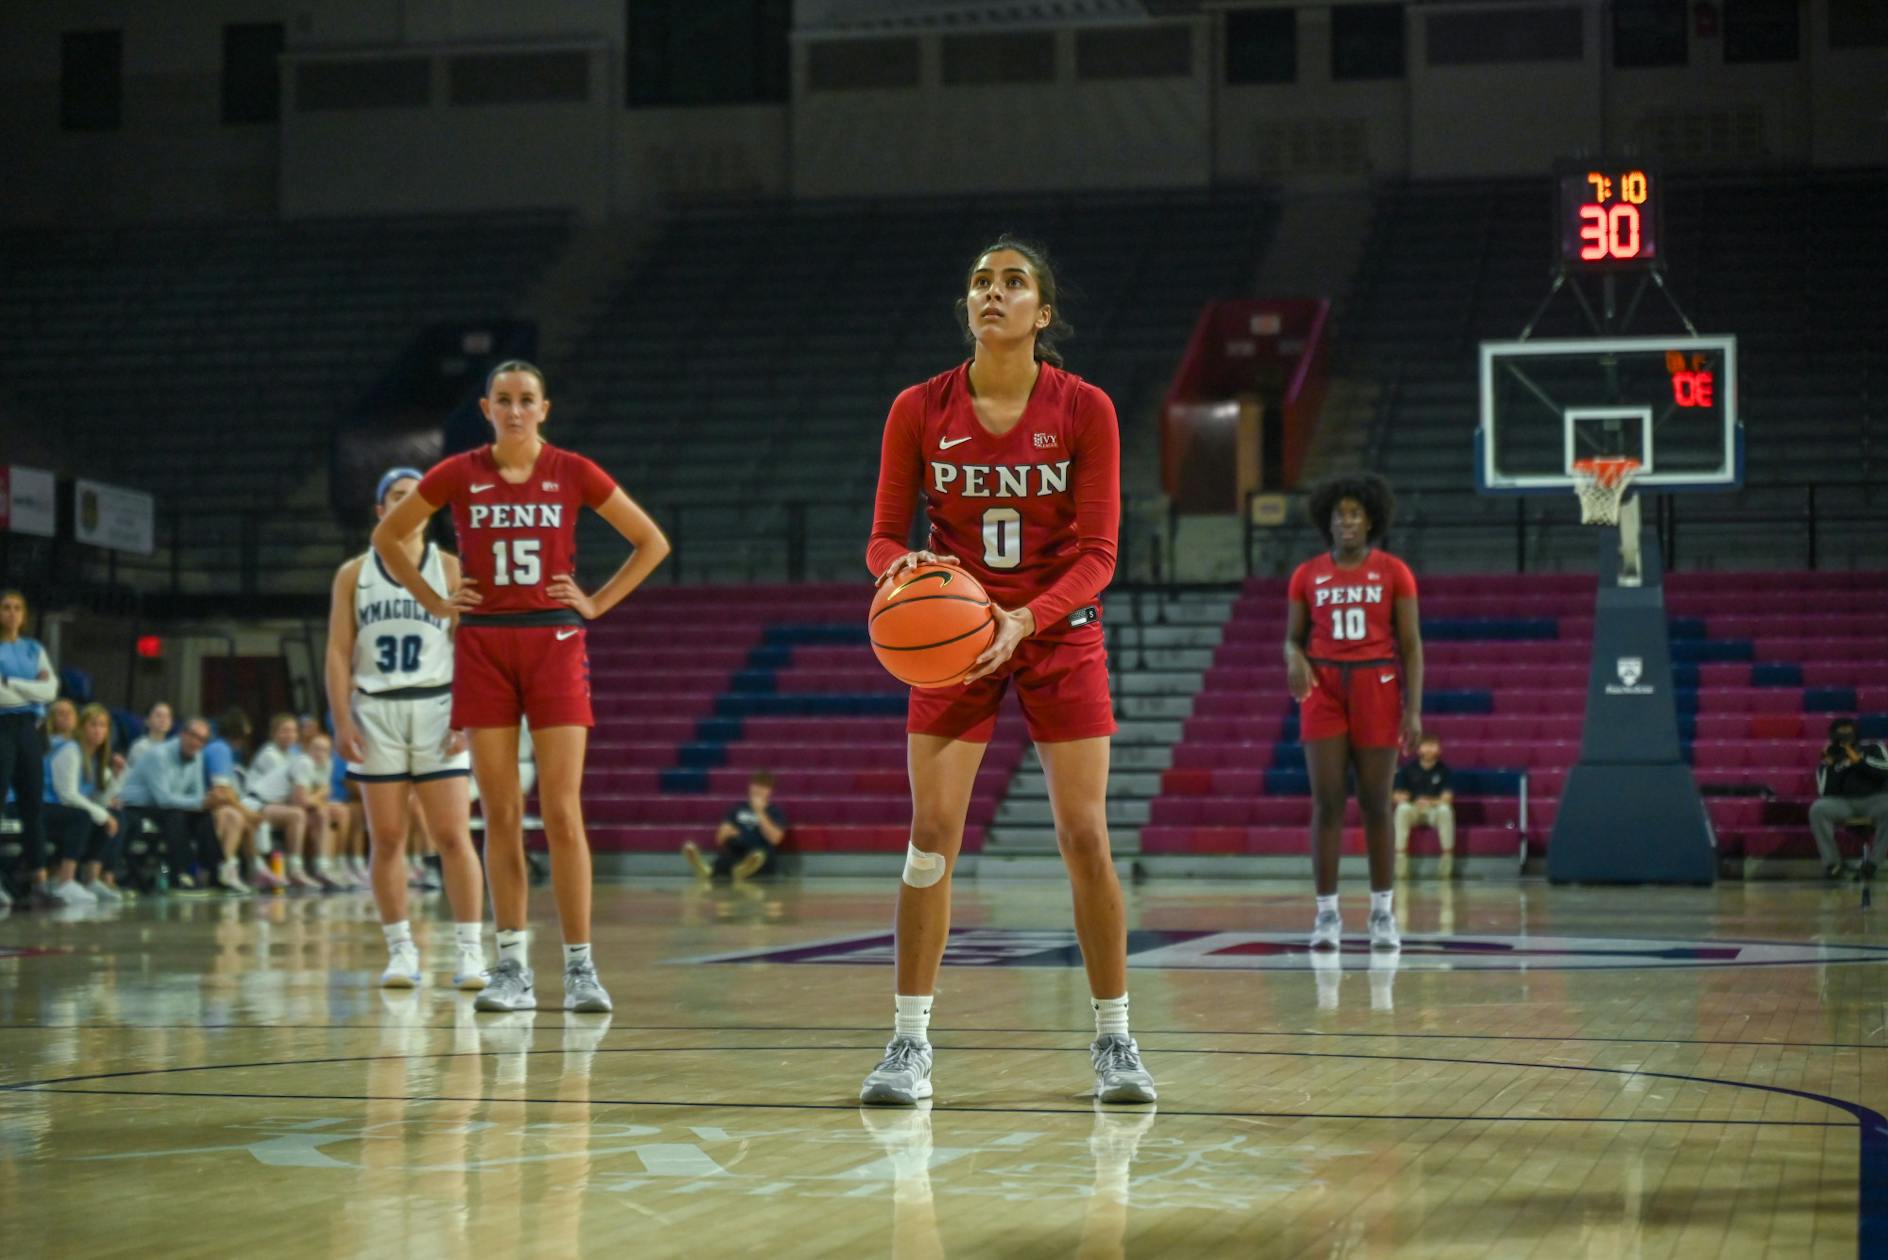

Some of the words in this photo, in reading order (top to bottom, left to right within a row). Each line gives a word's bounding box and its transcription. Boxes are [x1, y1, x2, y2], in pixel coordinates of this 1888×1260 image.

[1588, 171, 1647, 204] 7:10
[1580, 203, 1640, 260] 30
[931, 461, 1070, 497] PENN
[469, 504, 563, 528] PENN
[982, 507, 1021, 568] 0
[492, 539, 541, 586] 15
[1315, 585, 1382, 607] PENN
[1332, 607, 1366, 640] 10
[375, 634, 423, 673] 30
